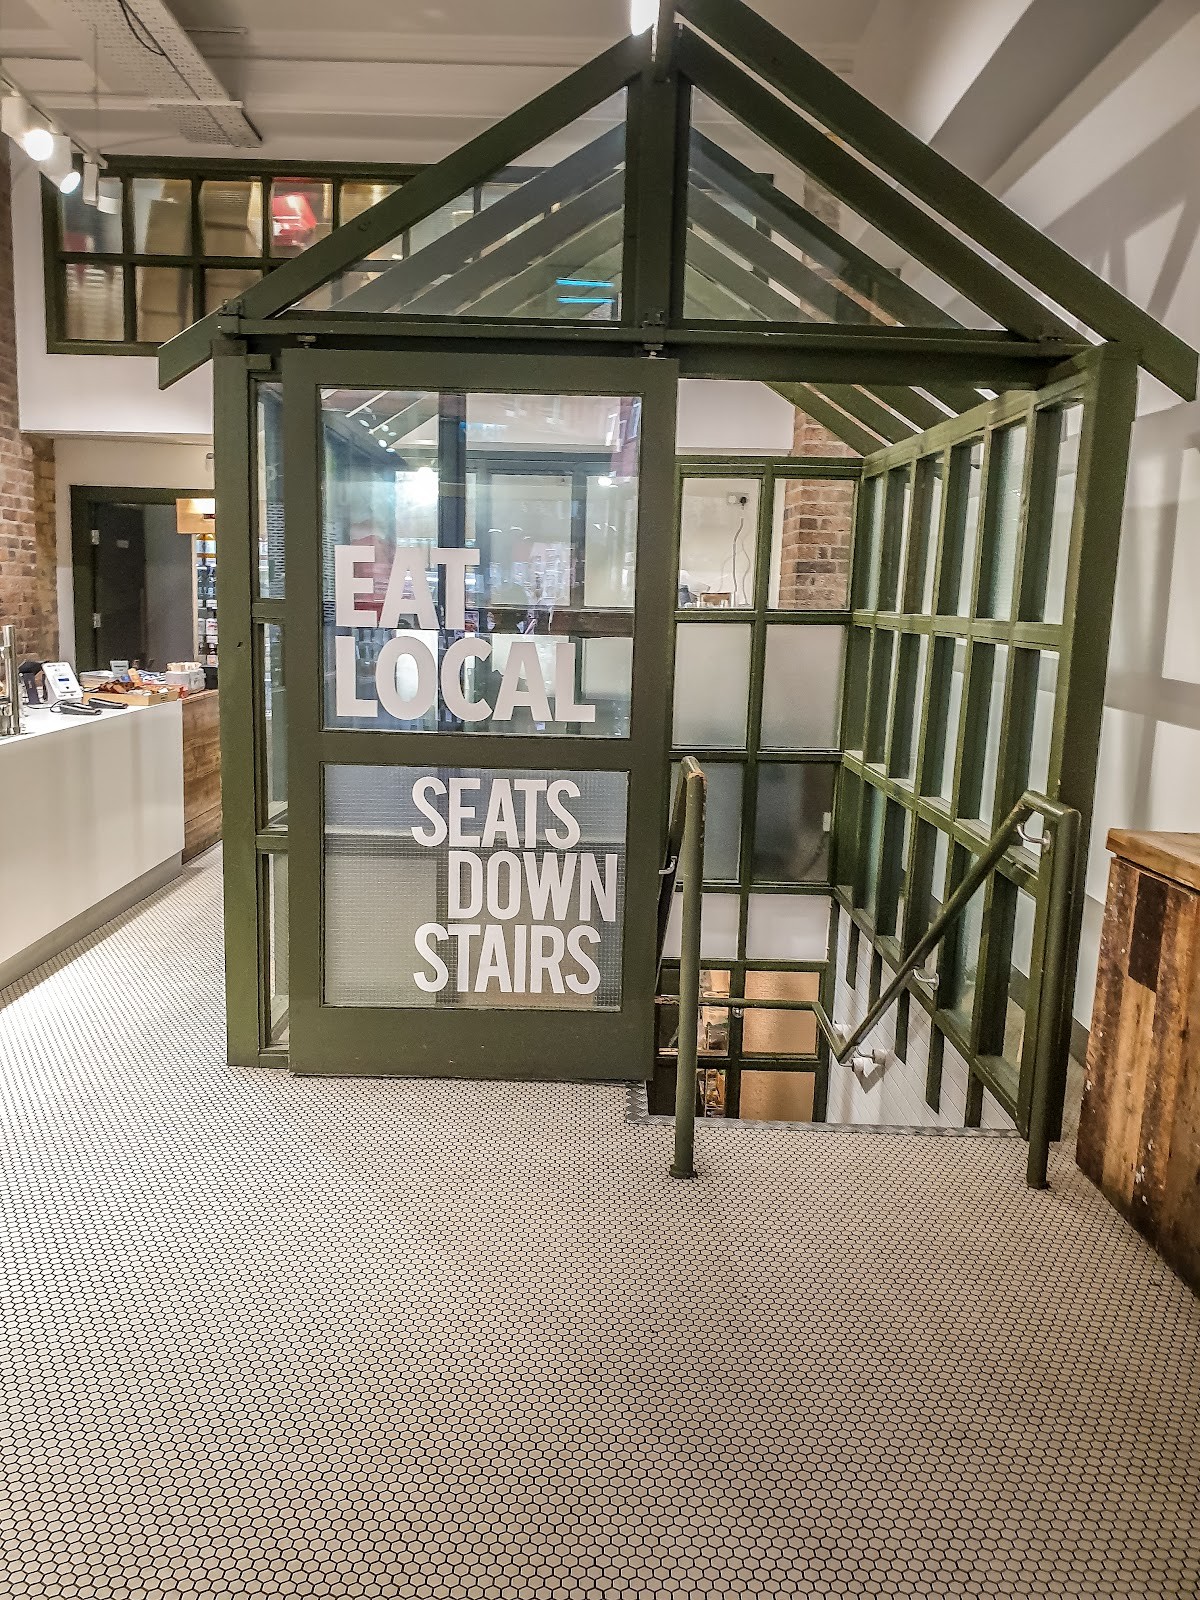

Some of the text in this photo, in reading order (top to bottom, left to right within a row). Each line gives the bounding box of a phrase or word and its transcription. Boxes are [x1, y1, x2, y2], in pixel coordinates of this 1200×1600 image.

[334, 545, 480, 629] EAT
[335, 636, 595, 722] LOCAL
[411, 777, 581, 849] SEATS
[448, 851, 617, 921] DOWN
[414, 923, 601, 995] STAIRS
